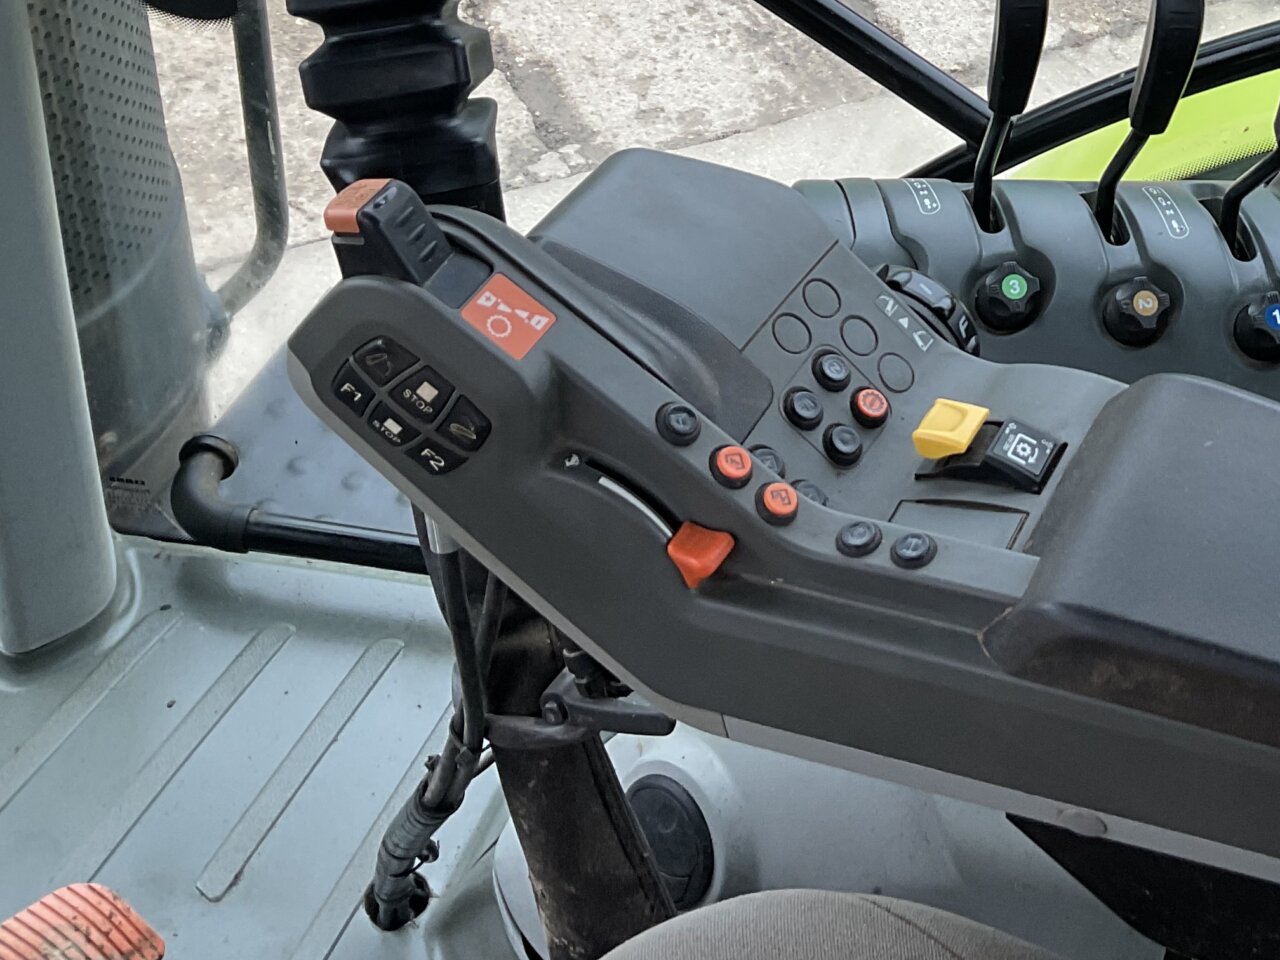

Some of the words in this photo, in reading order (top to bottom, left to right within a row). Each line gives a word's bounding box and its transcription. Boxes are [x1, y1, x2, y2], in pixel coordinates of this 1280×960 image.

[1009, 279, 1021, 293] 3
[1138, 298, 1154, 309] 2
[340, 382, 362, 403] F1
[402, 388, 433, 415] STOP
[372, 418, 402, 444] STOP
[420, 447, 446, 471] F2
